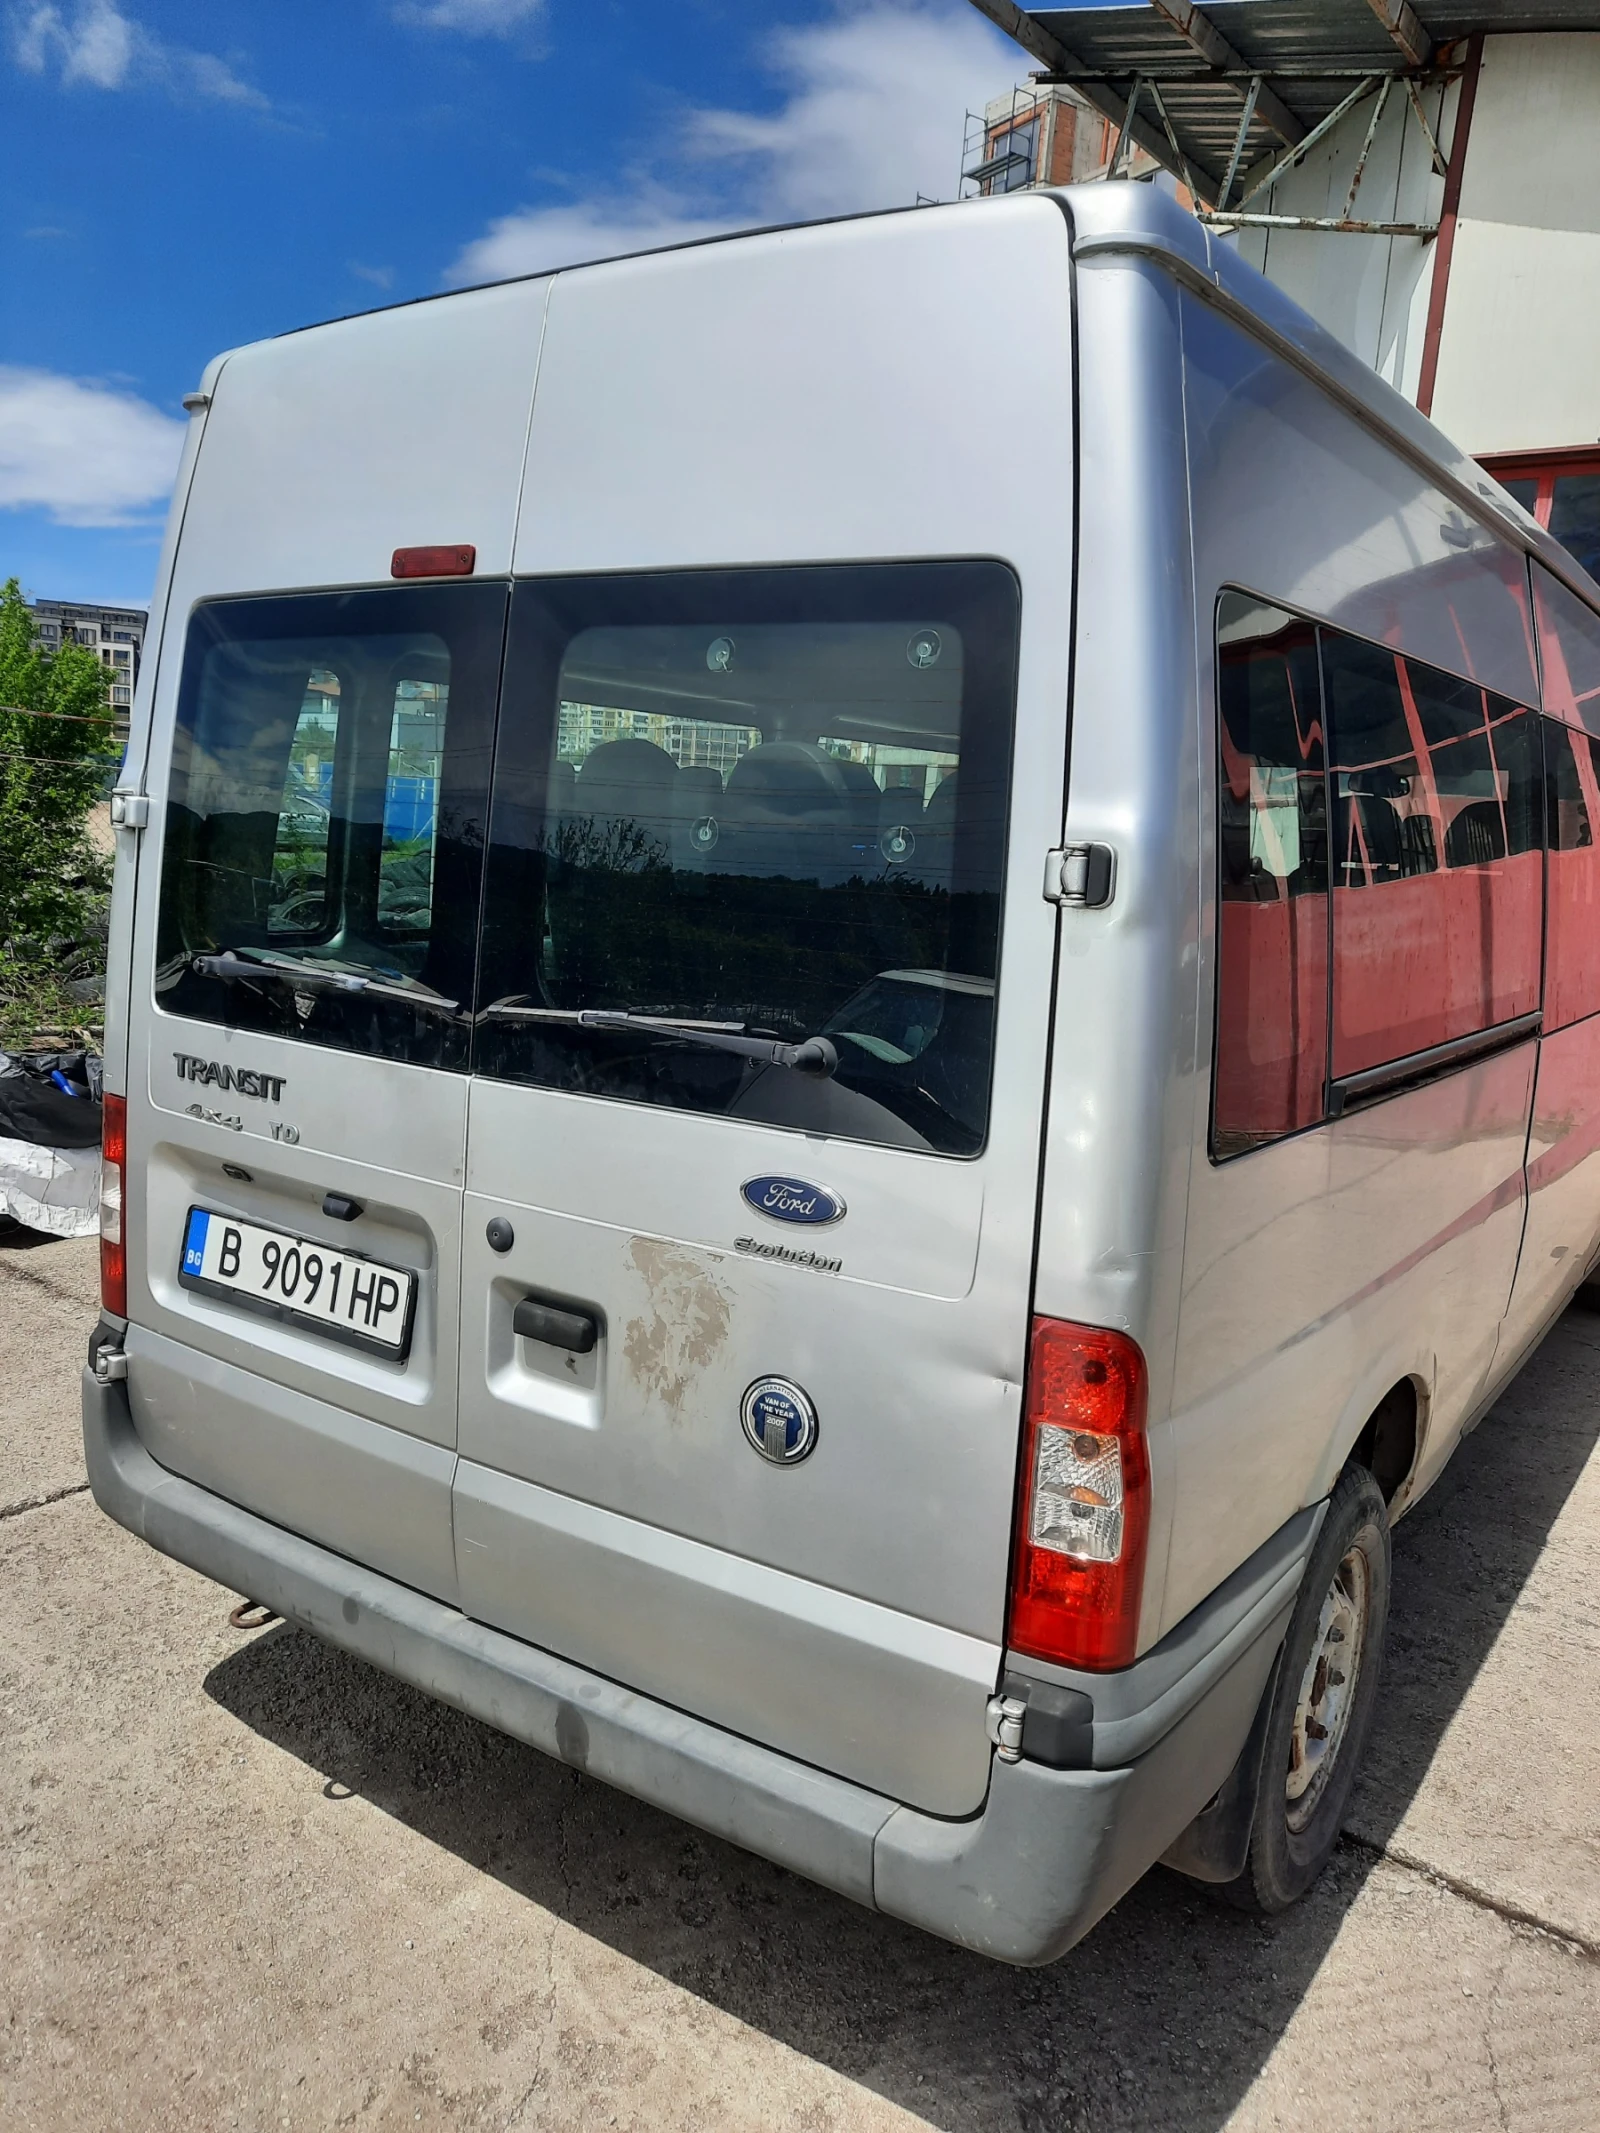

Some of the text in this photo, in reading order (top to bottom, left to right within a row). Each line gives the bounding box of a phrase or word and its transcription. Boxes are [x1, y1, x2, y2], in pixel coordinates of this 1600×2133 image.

[173, 1052, 287, 1102] TRANSIT
[268, 1120, 300, 1144] TD
[763, 1183, 817, 1215] Ford
[186, 1249, 202, 1266] BG
[218, 1226, 242, 1278] B
[733, 1234, 843, 1273] Evolution
[759, 1402, 795, 1419] THE YEAR
[764, 1396, 791, 1409] VAN OF
[766, 1416, 785, 1428] 2007
